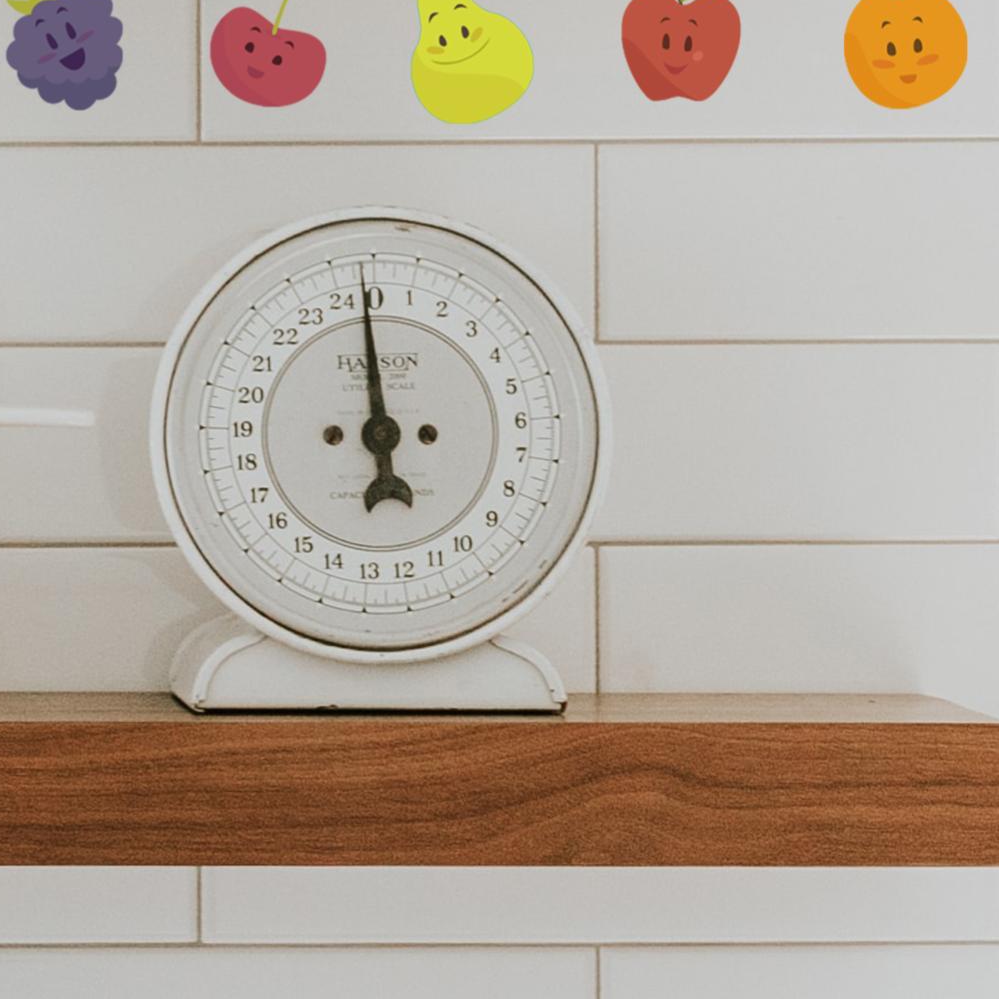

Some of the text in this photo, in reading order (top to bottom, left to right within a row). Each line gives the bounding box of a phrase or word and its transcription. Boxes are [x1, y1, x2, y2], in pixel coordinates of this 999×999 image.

[329, 292, 355, 311] 24
[365, 286, 384, 310] 0
[406, 289, 413, 306] 1
[298, 307, 324, 326] 23
[435, 300, 448, 318] 2
[272, 327, 299, 346] 22
[465, 320, 478, 338] 3
[252, 355, 272, 373] 21
[337, 353, 418, 372] HASON
[489, 347, 501, 364] 4
[238, 386, 265, 404] 20
[505, 378, 518, 395] 5
[233, 420, 254, 438] 19
[514, 411, 528, 430] 6
[237, 453, 258, 471] 18
[515, 446, 528, 463] 7
[250, 486, 270, 504] 17
[503, 479, 516, 498] 8
[268, 511, 288, 530] 16
[485, 510, 499, 528] 9
[294, 535, 314, 554] 15
[453, 534, 474, 553] 10
[324, 553, 343, 570] 14
[427, 550, 444, 567] 11
[360, 561, 380, 580] 13
[394, 560, 415, 579] 12
